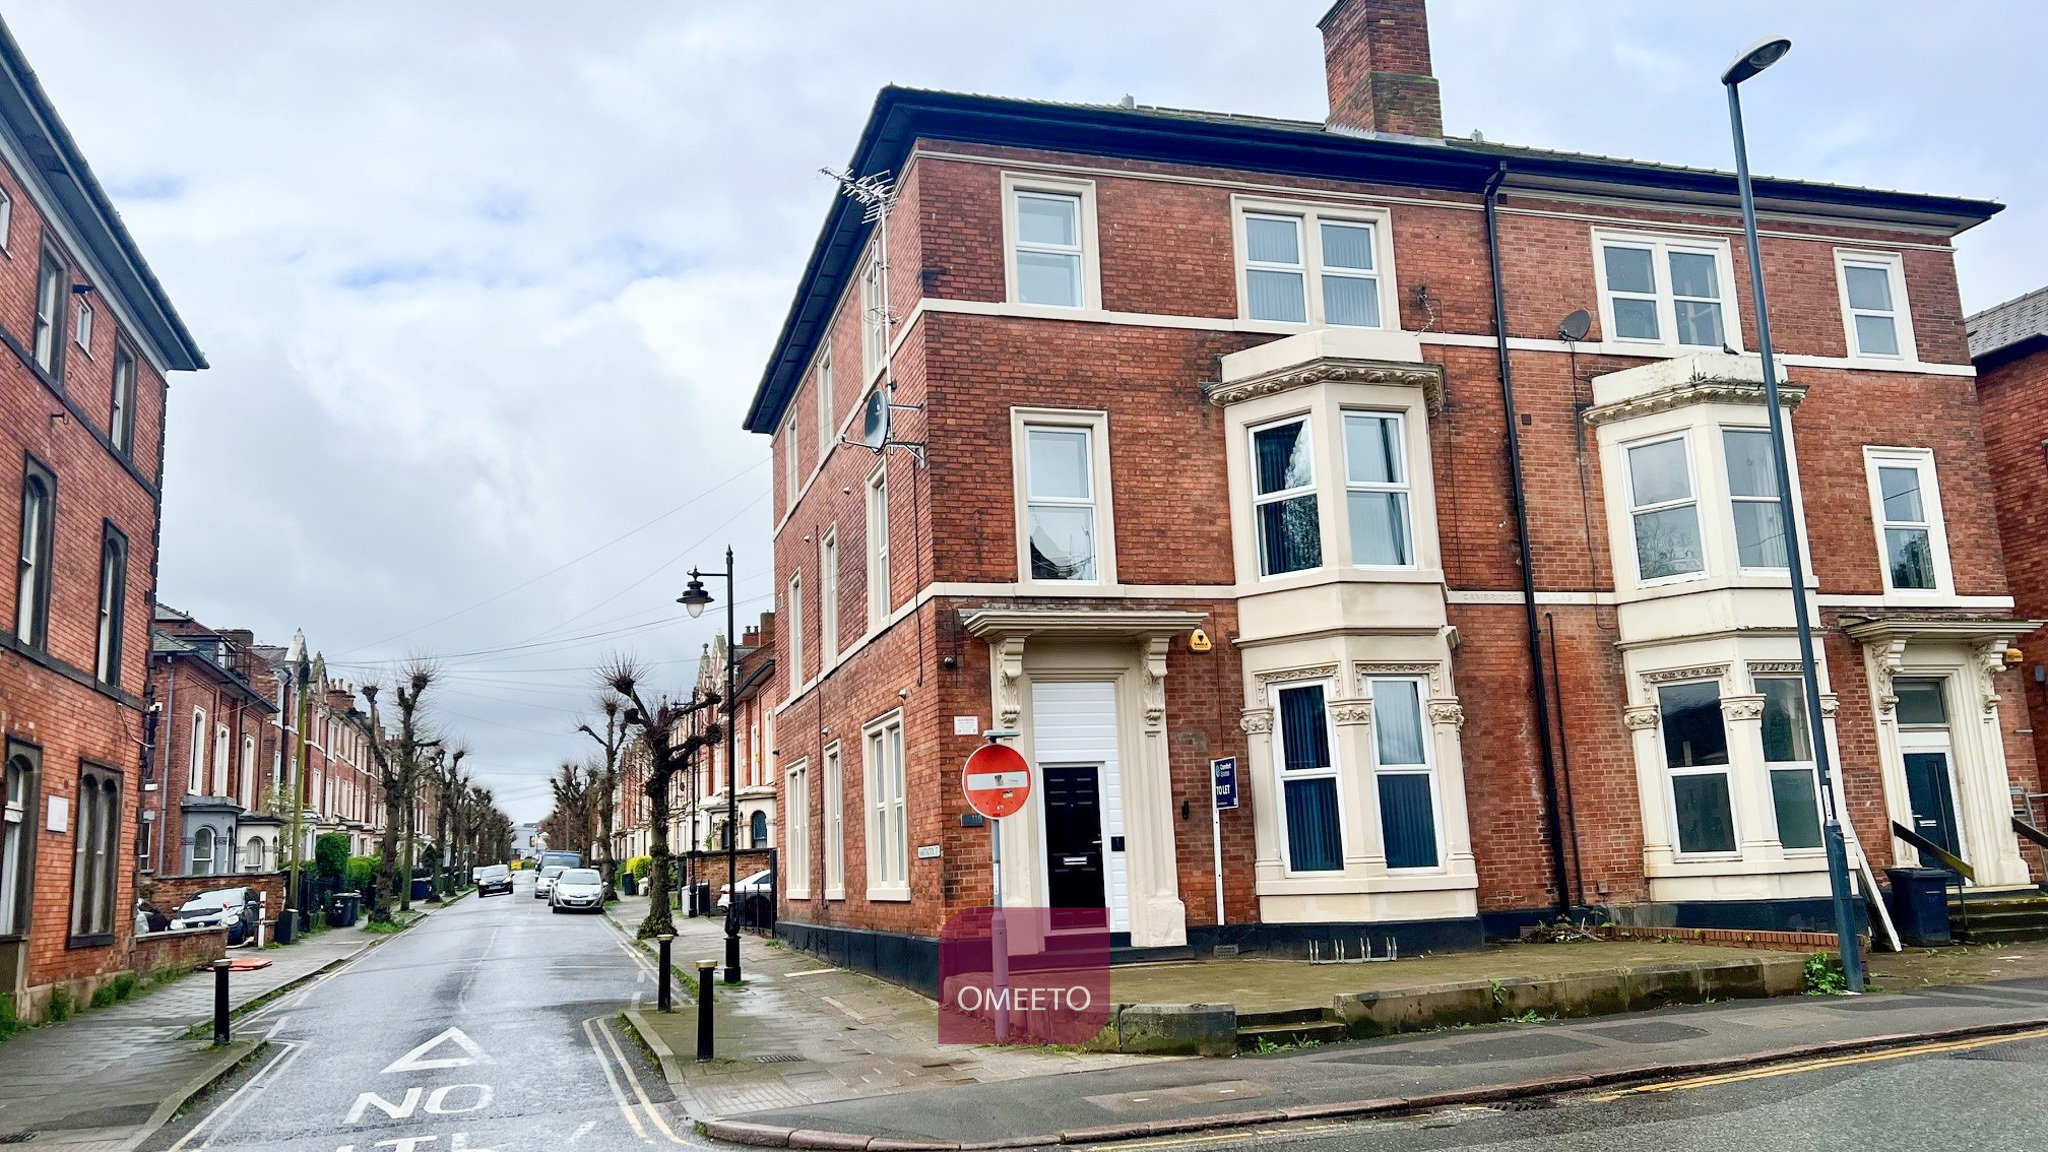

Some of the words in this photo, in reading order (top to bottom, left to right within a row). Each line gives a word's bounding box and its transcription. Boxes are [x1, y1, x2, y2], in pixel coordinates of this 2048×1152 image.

[1216, 785, 1222, 795] TO
[1222, 784, 1230, 795] LET
[342, 1084, 493, 1124] NO
